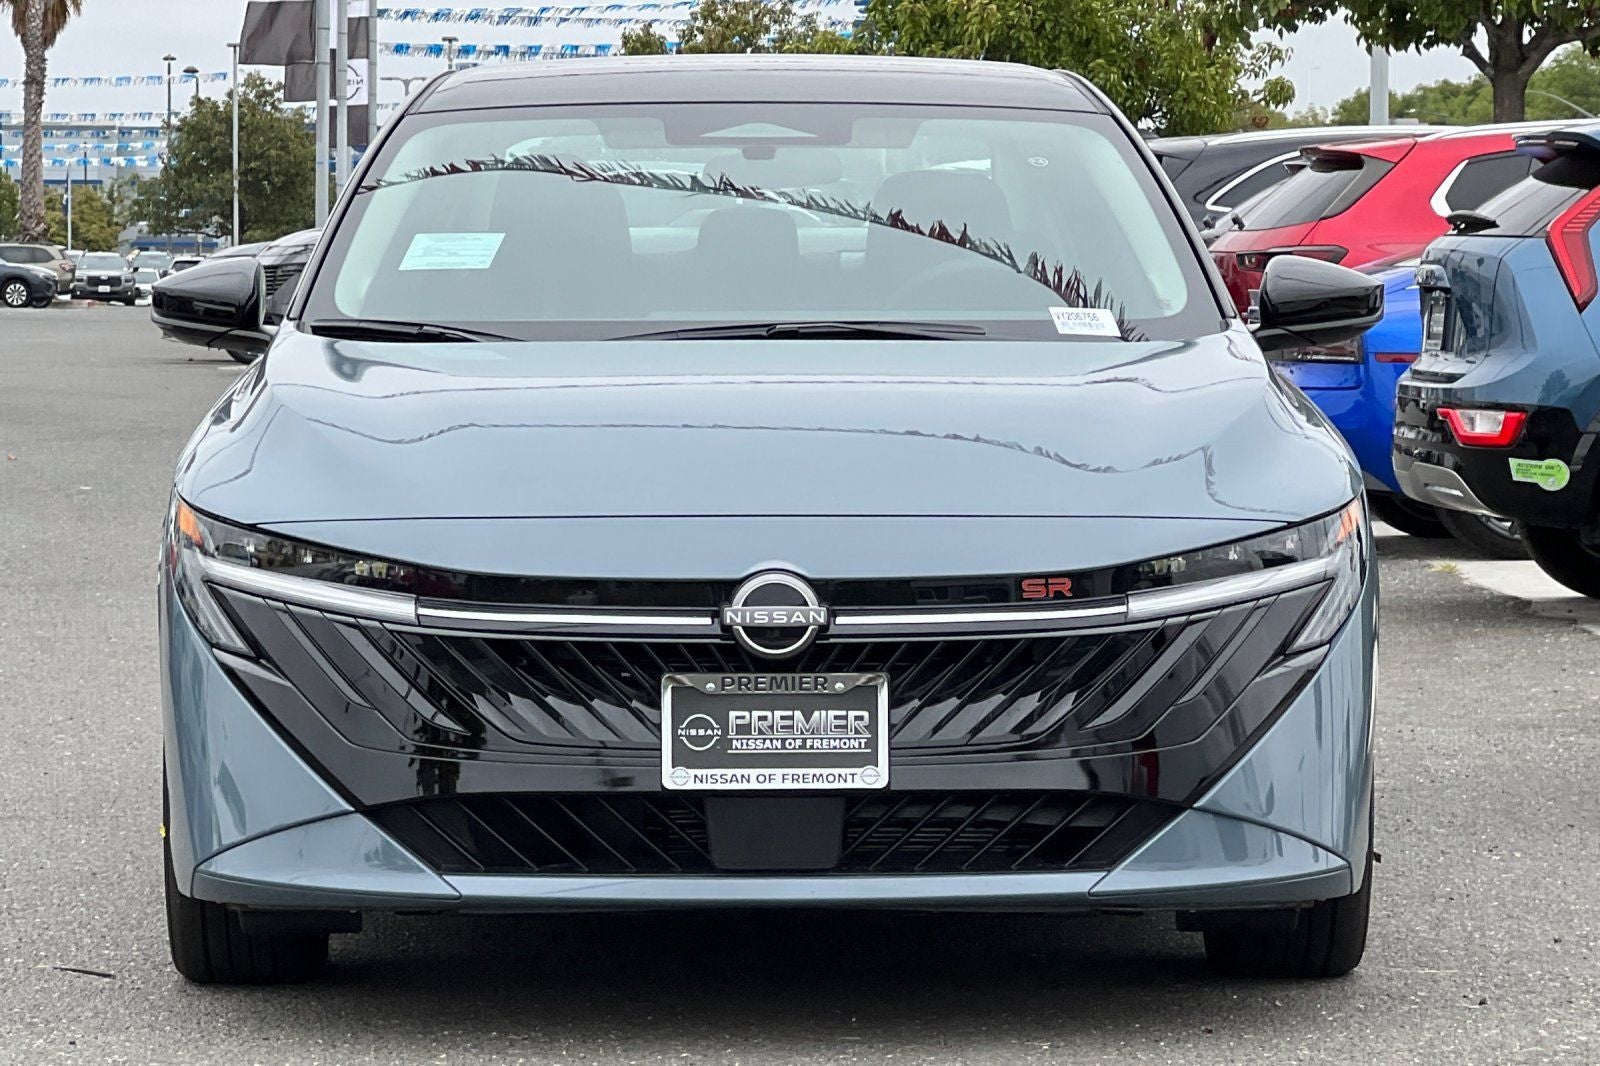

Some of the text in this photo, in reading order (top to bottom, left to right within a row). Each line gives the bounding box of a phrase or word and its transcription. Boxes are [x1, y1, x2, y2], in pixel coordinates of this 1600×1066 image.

[1021, 577, 1073, 599] SR
[726, 611, 825, 624] NISSAN
[720, 676, 829, 693] PREMIER
[728, 710, 870, 735] PREMIER
[677, 728, 722, 736] NISSAN
[732, 738, 868, 750] NISSAN OF FREMONT
[693, 773, 751, 785] NISSAN
[756, 773, 777, 785] OF
[781, 772, 858, 784] FREMONT
